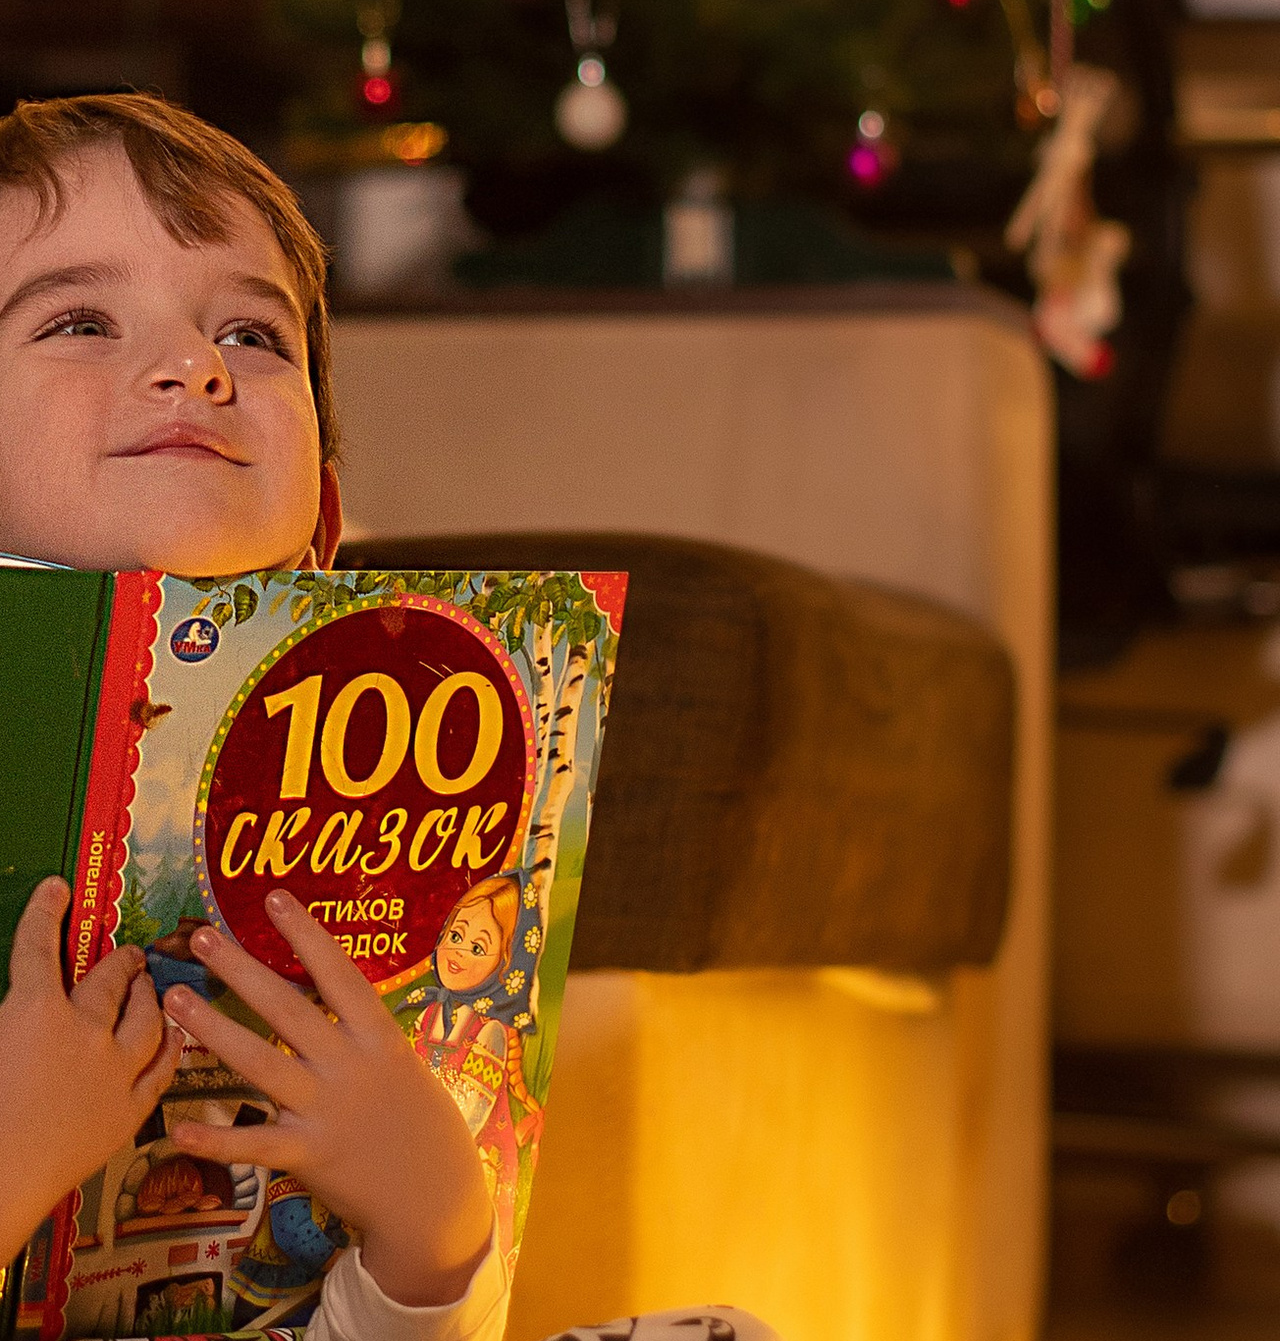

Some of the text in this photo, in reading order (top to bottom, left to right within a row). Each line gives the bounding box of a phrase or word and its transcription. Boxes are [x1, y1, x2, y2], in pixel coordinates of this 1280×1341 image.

[263, 671, 504, 800] 100
[83, 830, 105, 909] загадок
[220, 802, 508, 879] сказок
